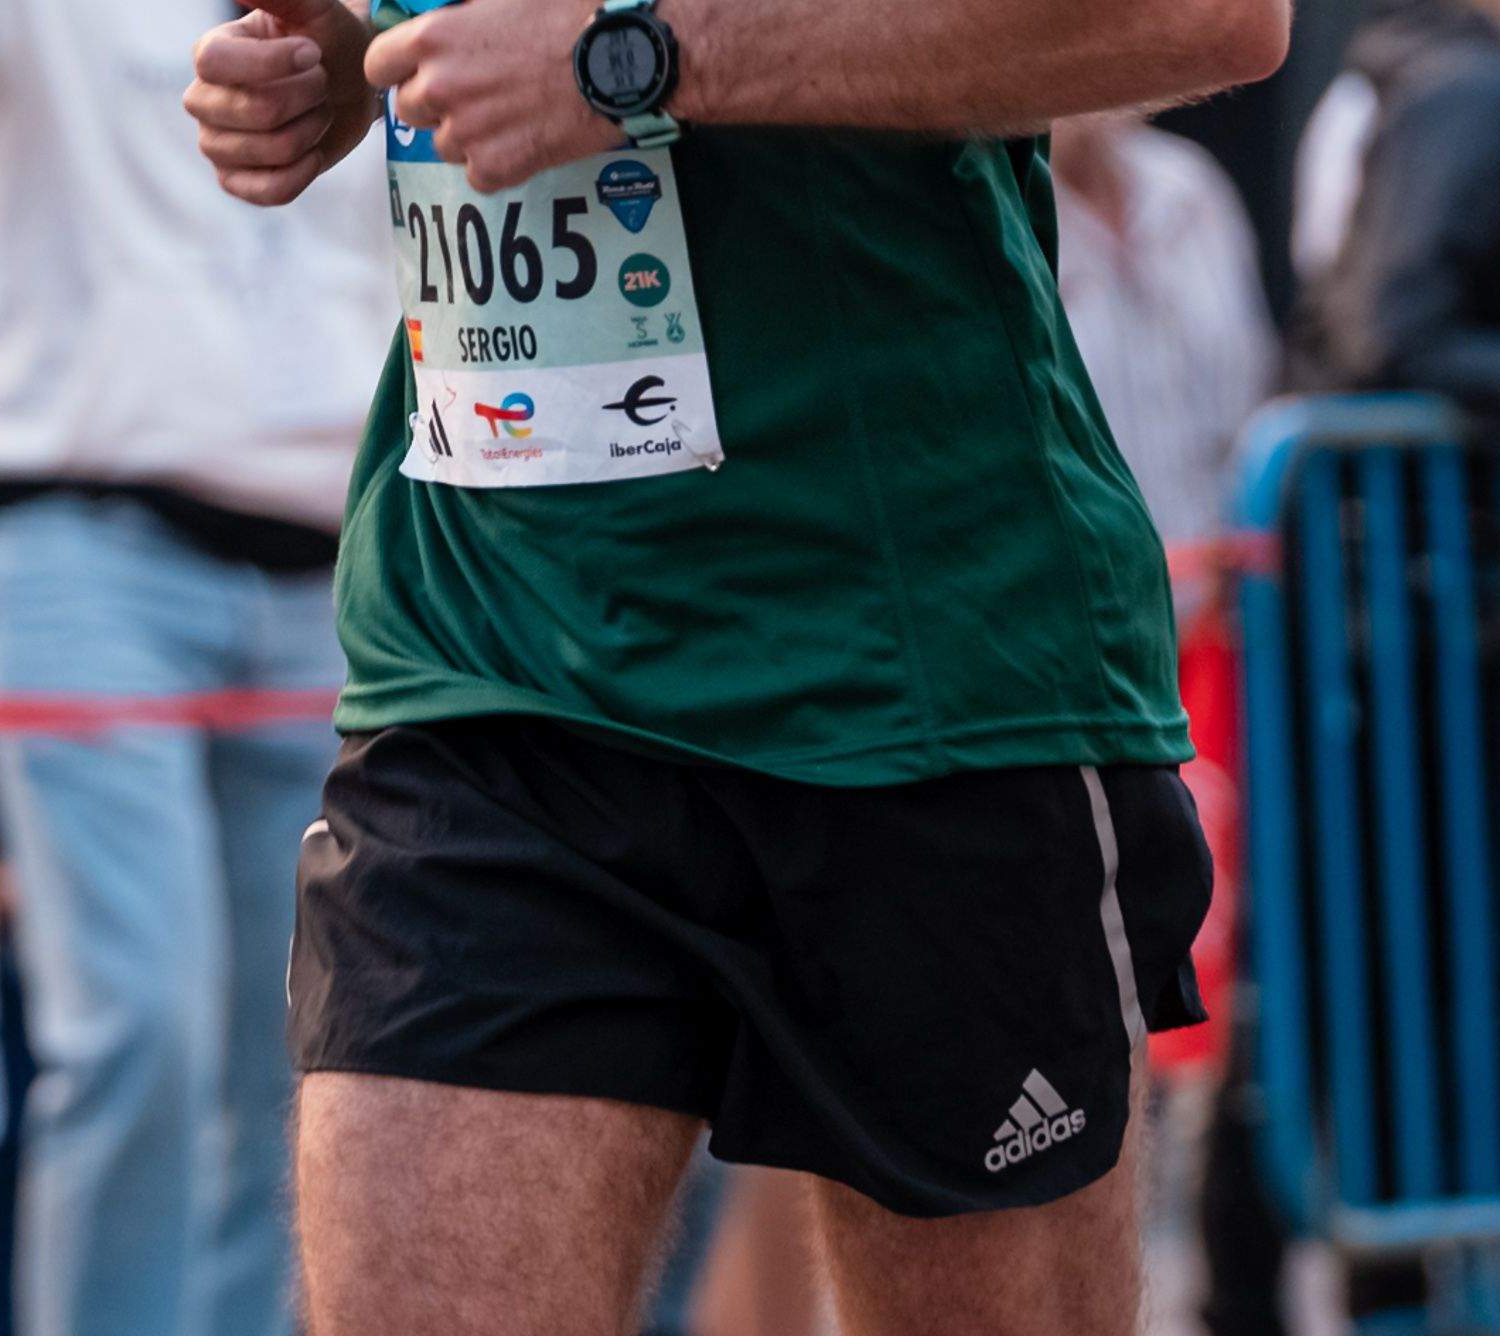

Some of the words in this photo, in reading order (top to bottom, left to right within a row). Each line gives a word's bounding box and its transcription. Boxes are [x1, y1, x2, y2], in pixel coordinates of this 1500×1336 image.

[408, 197, 598, 306] 21065
[624, 269, 662, 291] 21K
[457, 324, 538, 363] SERGIO
[984, 1108, 1087, 1172] adidas
